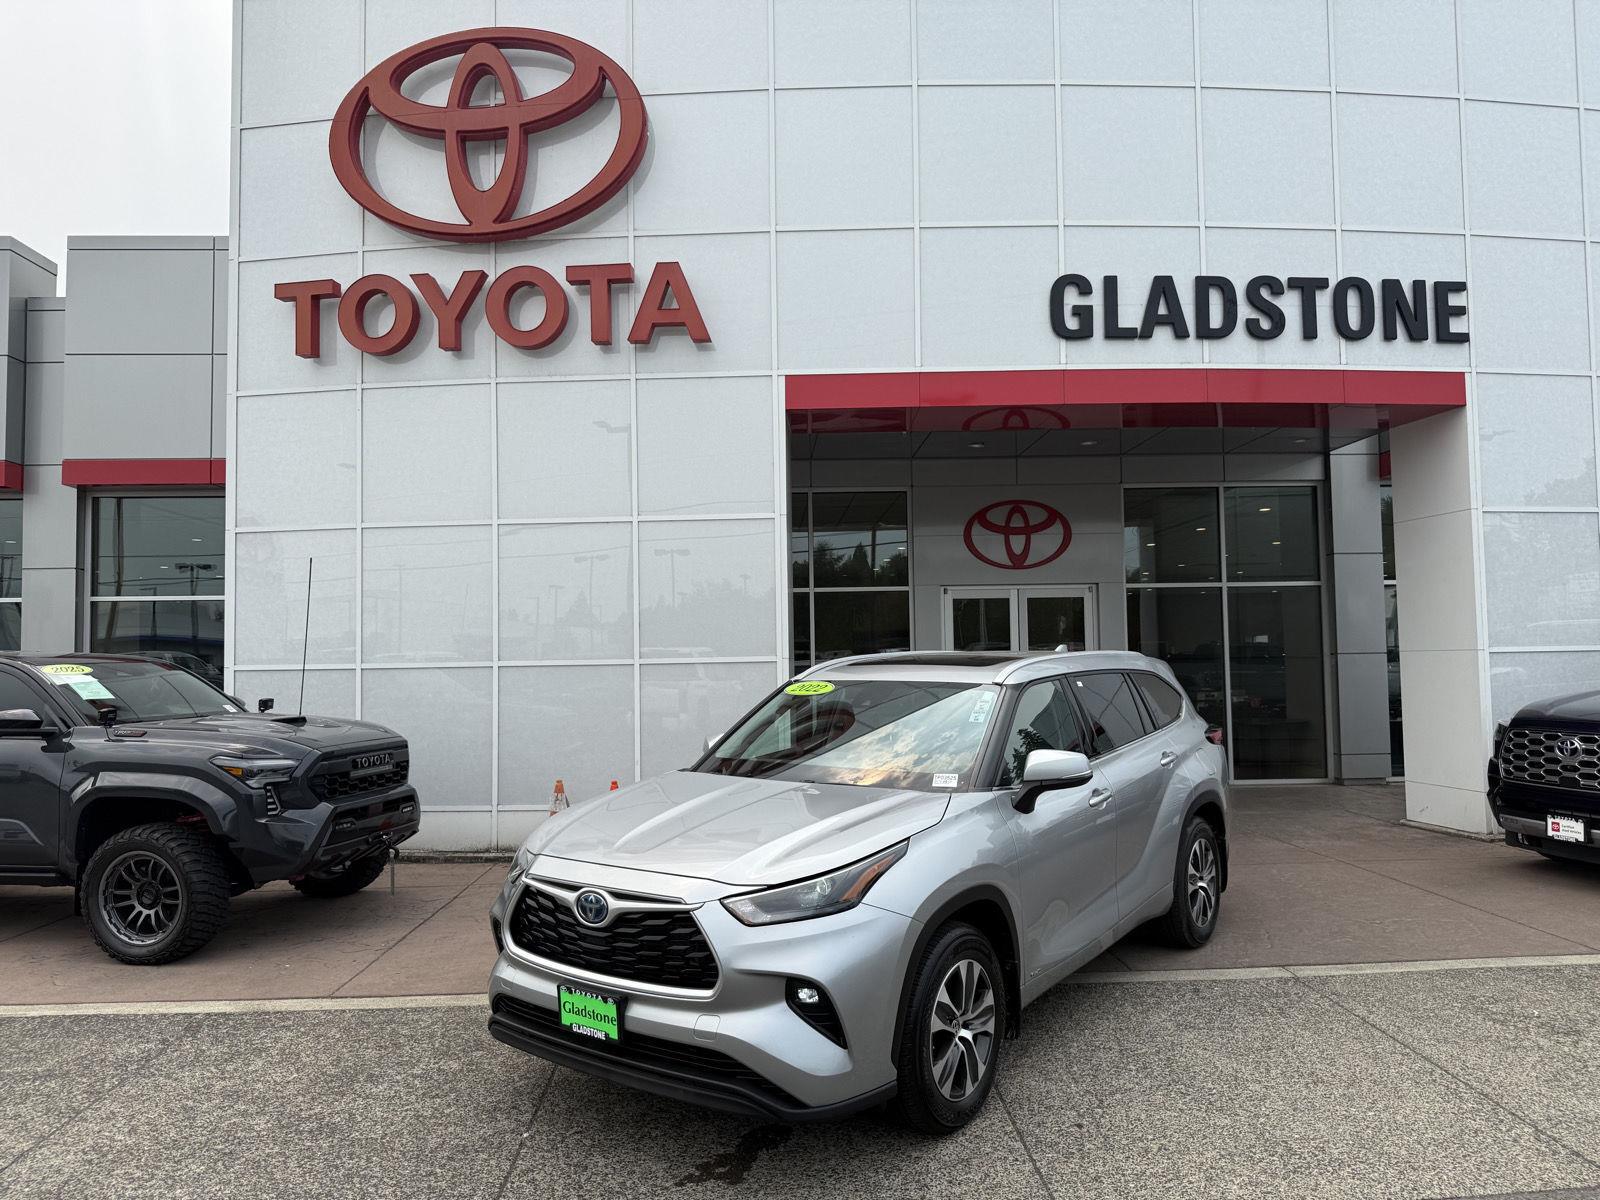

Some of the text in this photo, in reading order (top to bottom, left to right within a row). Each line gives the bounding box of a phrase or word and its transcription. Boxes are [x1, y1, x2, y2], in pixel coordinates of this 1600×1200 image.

[274, 261, 712, 359] TOYOTA
[1049, 273, 1470, 343] GLADSTONE
[355, 753, 391, 768] TOYOTA
[571, 988, 602, 1001] TOYOTA
[562, 1000, 617, 1026] Gladstone
[572, 1023, 606, 1040] GLADSTONE
